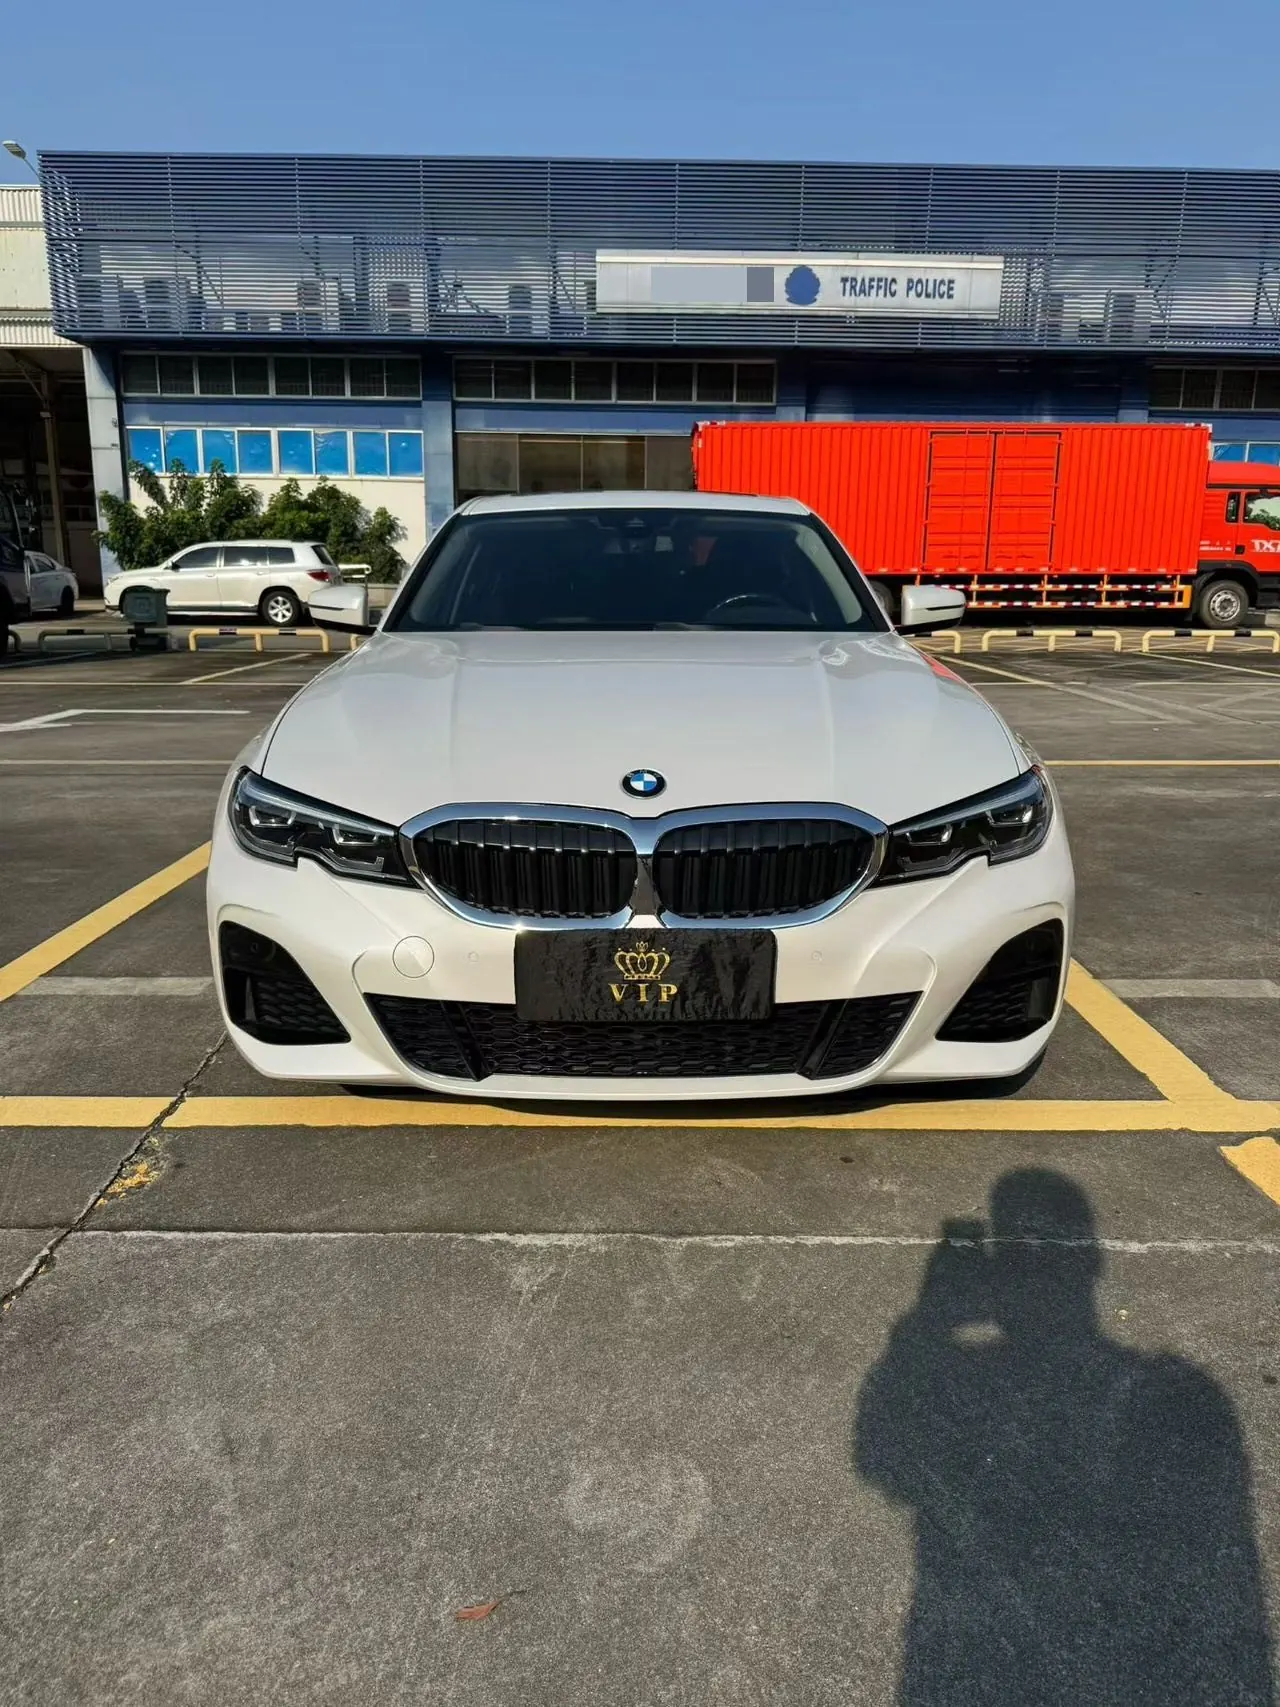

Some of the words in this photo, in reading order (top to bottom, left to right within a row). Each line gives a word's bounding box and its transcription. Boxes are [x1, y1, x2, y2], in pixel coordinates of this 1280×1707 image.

[840, 276, 897, 298] TRAFFIC
[906, 278, 956, 300] POLICE
[607, 983, 678, 1003] VIP
